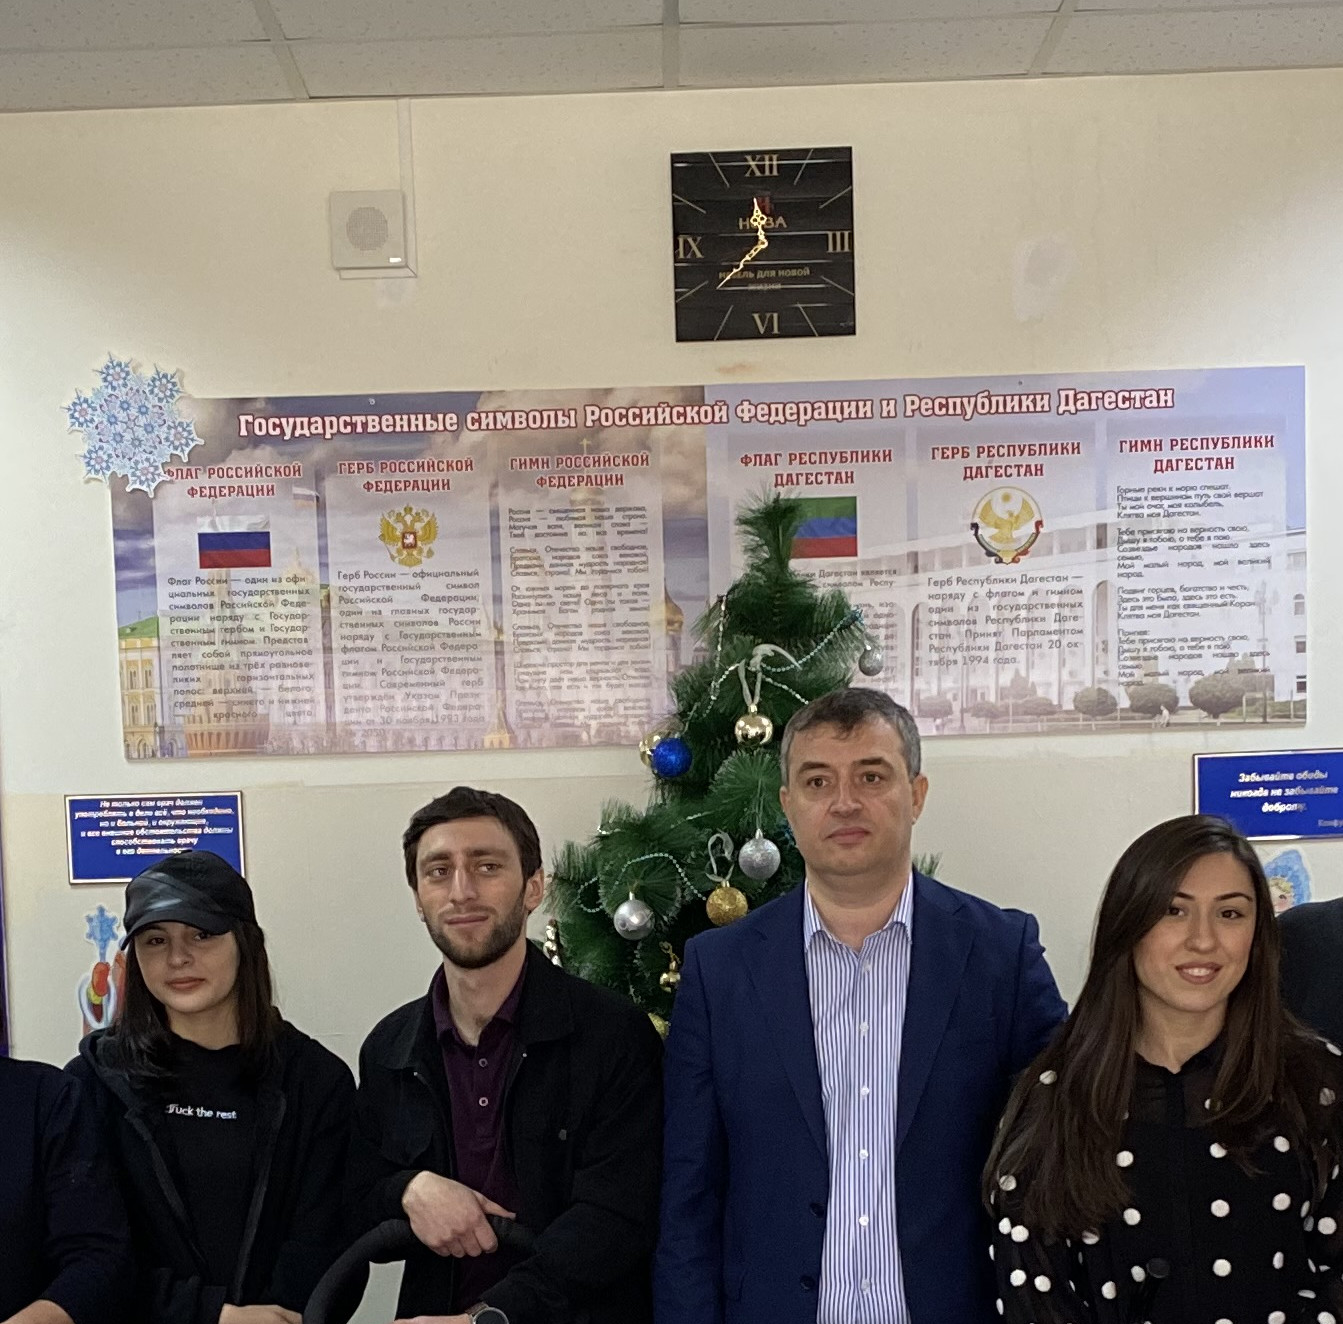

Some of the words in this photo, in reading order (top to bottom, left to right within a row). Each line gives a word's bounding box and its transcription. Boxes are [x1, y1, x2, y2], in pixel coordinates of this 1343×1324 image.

[744, 154, 780, 177] XII
[678, 235, 704, 259] IX
[827, 231, 852, 253] III
[752, 312, 780, 335] VI
[239, 413, 458, 440] Государственные
[465, 407, 578, 431] символы
[584, 400, 730, 428] Российской
[735, 399, 874, 426] Федерации
[880, 398, 897, 419] и
[904, 390, 1051, 422] Республики
[1057, 386, 1175, 415] Дагестан
[931, 445, 970, 461] ГЕРБ
[976, 442, 1081, 459] РЕСПУБЛИКИ
[1119, 438, 1164, 453] ГИМН
[1170, 434, 1275, 452] РЕСПУБЛИКИ
[338, 461, 375, 475] ГЕРБ
[380, 458, 474, 474] РОССИЙСКОЙ
[510, 457, 550, 471] ГИМН
[555, 452, 650, 468] РОССИЙСКОЙ
[740, 453, 783, 468] ФЛАГ
[788, 449, 892, 466] РЕСПУБЛИКИ
[1153, 457, 1235, 474] ДАГЕСТАН
[208, 464, 302, 480] РОССИЙСКОЙ
[774, 471, 855, 488] ДАГЕСТАН
[963, 464, 1044, 481] ДАГЕСТАН
[363, 479, 451, 494] ФЕДЕРАЦИИ
[536, 474, 625, 489] ФЕДЕРАЦИИ
[187, 483, 275, 500] ФЕДЕРАЦИИ
[337, 571, 360, 580] Герб
[928, 577, 953, 587] Герб
[957, 576, 1017, 587] Республики
[1020, 574, 1069, 584] Дагестан
[1048, 640, 1061, 649] 20
[963, 656, 988, 665] 1994
[196, 1107, 213, 1117] the
[216, 1111, 236, 1119] rest
